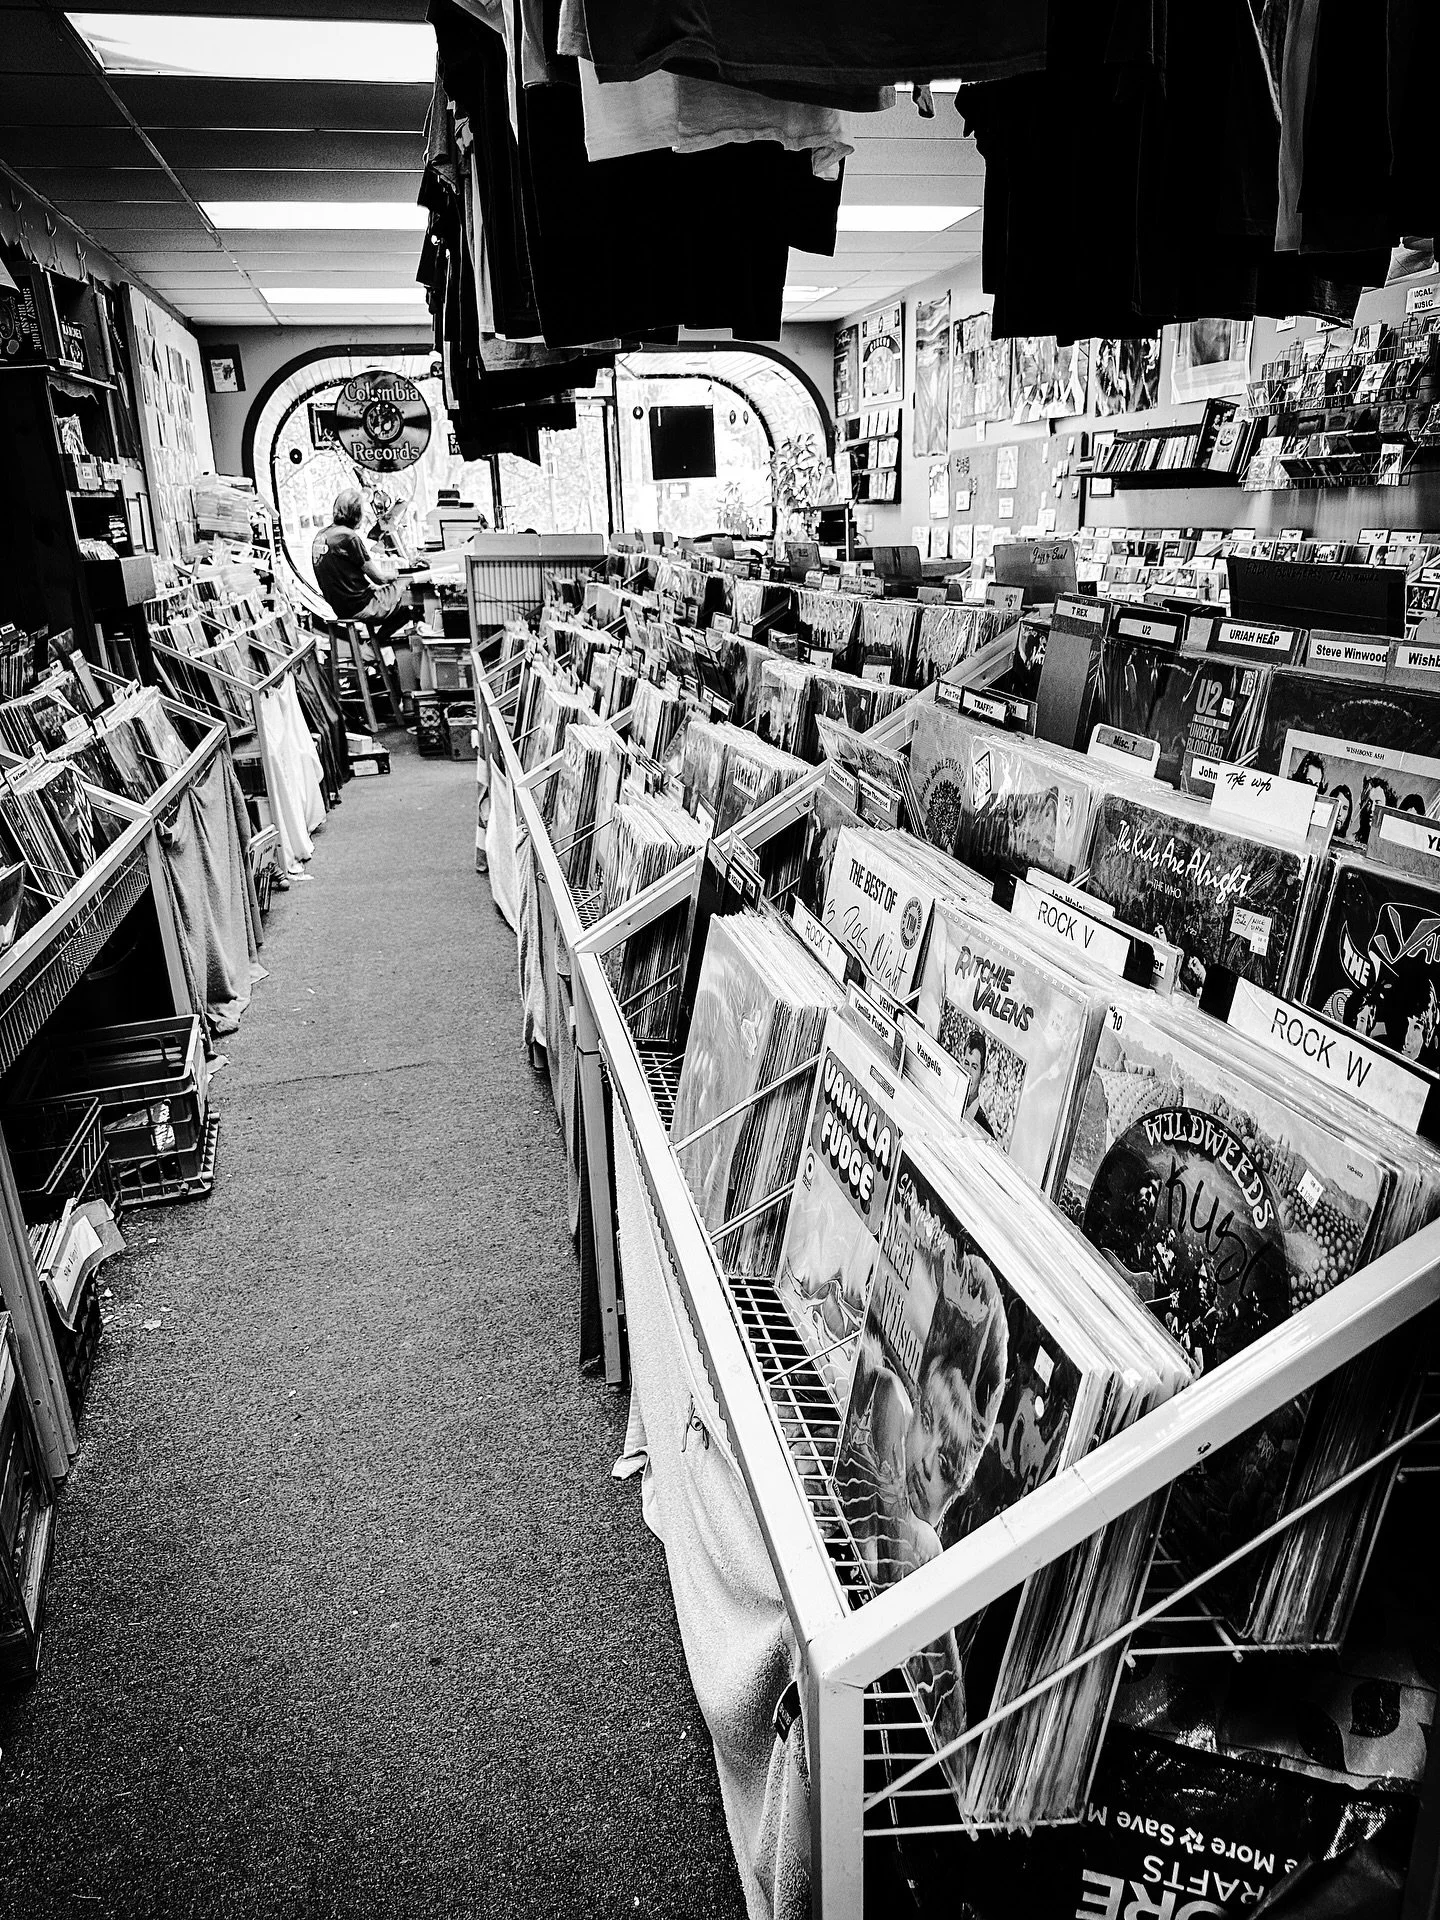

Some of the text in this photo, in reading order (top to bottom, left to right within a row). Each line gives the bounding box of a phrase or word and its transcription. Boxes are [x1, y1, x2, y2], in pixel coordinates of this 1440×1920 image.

[1414, 288, 1433, 298] LOCAL
[1414, 300, 1434, 310] MUSIC
[351, 442, 420, 461] Records
[1076, 608, 1088, 618] REX
[1142, 624, 1152, 636] U2
[1230, 629, 1280, 646] URIAH HEAP
[1316, 644, 1388, 664] Steve Winwood
[974, 700, 994, 714] TRAFFIC
[1196, 678, 1223, 716] U2
[1112, 735, 1138, 752] Misc. T
[1213, 729, 1220, 744] A
[1346, 746, 1385, 760] WISHBONE ASH
[1198, 765, 1218, 780] John
[1116, 820, 1252, 904] The Kids Are Alright
[849, 858, 898, 914] THE BEST OF
[1153, 878, 1182, 899] THE WHO
[805, 920, 825, 951] ROCK
[1038, 900, 1094, 949] ROCK V
[954, 946, 1015, 992] RITCHIE
[1343, 933, 1371, 986] THE
[1034, 968, 1084, 1004] SERIES
[854, 998, 889, 1039] Vanilla Fudge
[972, 978, 1034, 1031] VALENS
[916, 1042, 942, 1076] Vangelis
[1270, 1008, 1373, 1088] ROCK W
[824, 1058, 892, 1167] VANILLA
[822, 1110, 875, 1202] FUDGE
[1143, 1110, 1274, 1230] WILDWEEDS
[1116, 1810, 1176, 1847] Save
[1210, 1836, 1275, 1874] More
